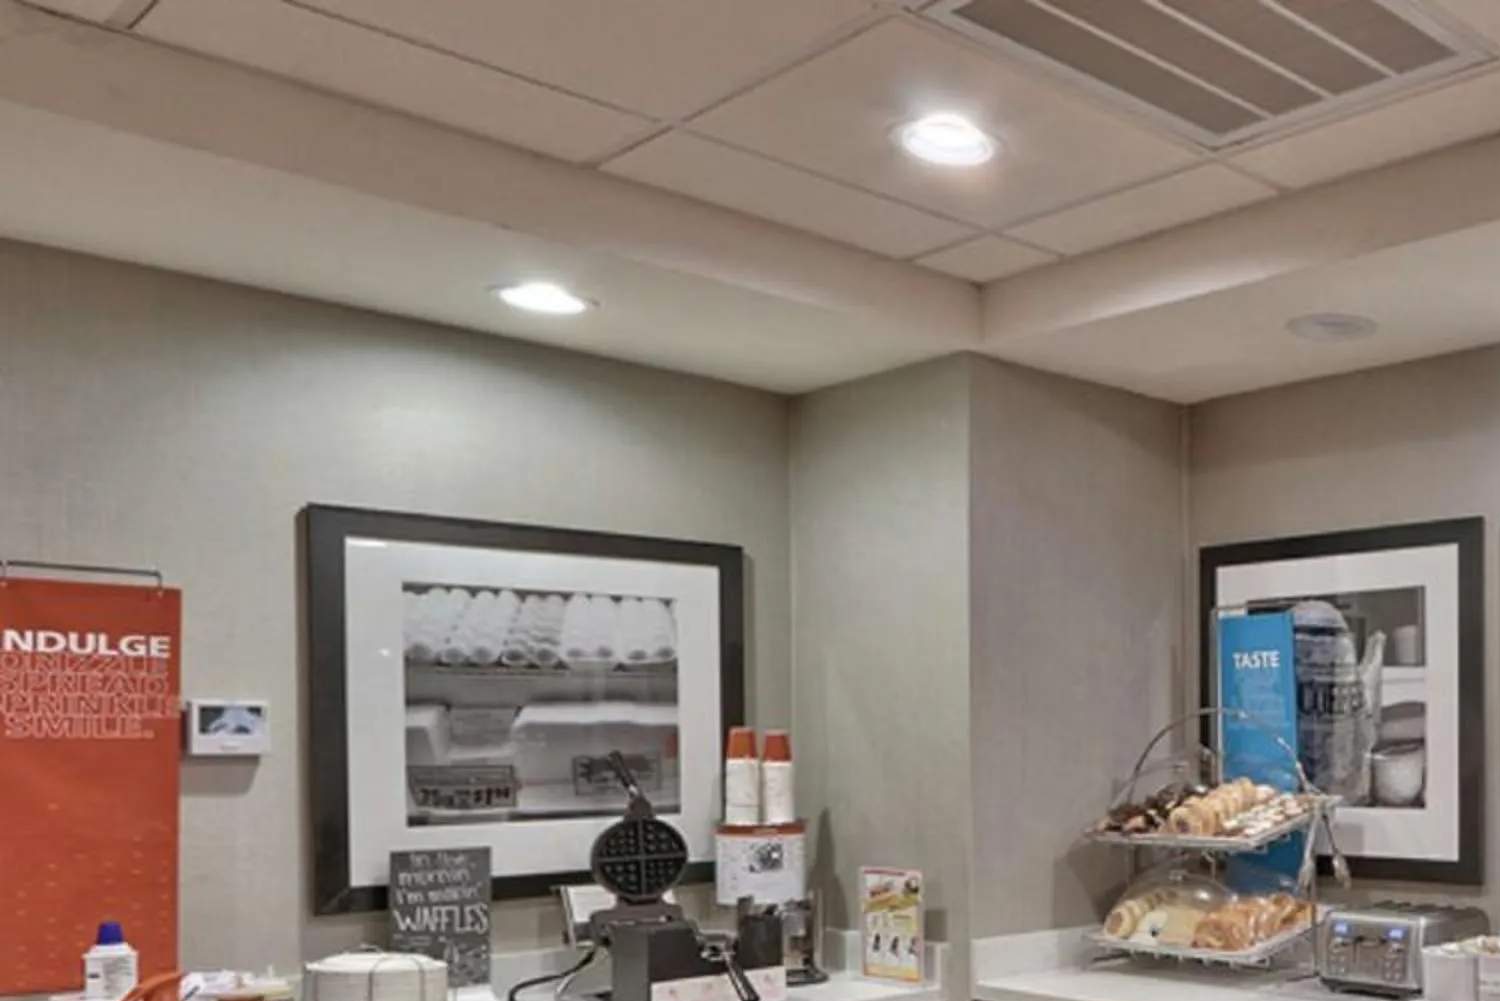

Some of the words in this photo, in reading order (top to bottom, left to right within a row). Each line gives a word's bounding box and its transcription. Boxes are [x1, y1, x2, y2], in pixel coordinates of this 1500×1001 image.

[3, 629, 171, 658] NDULGE
[1232, 650, 1280, 669] TASTE
[0, 692, 178, 718] PRINKLE
[4, 713, 154, 739] SMILE.
[393, 902, 488, 934] WAFFLES
